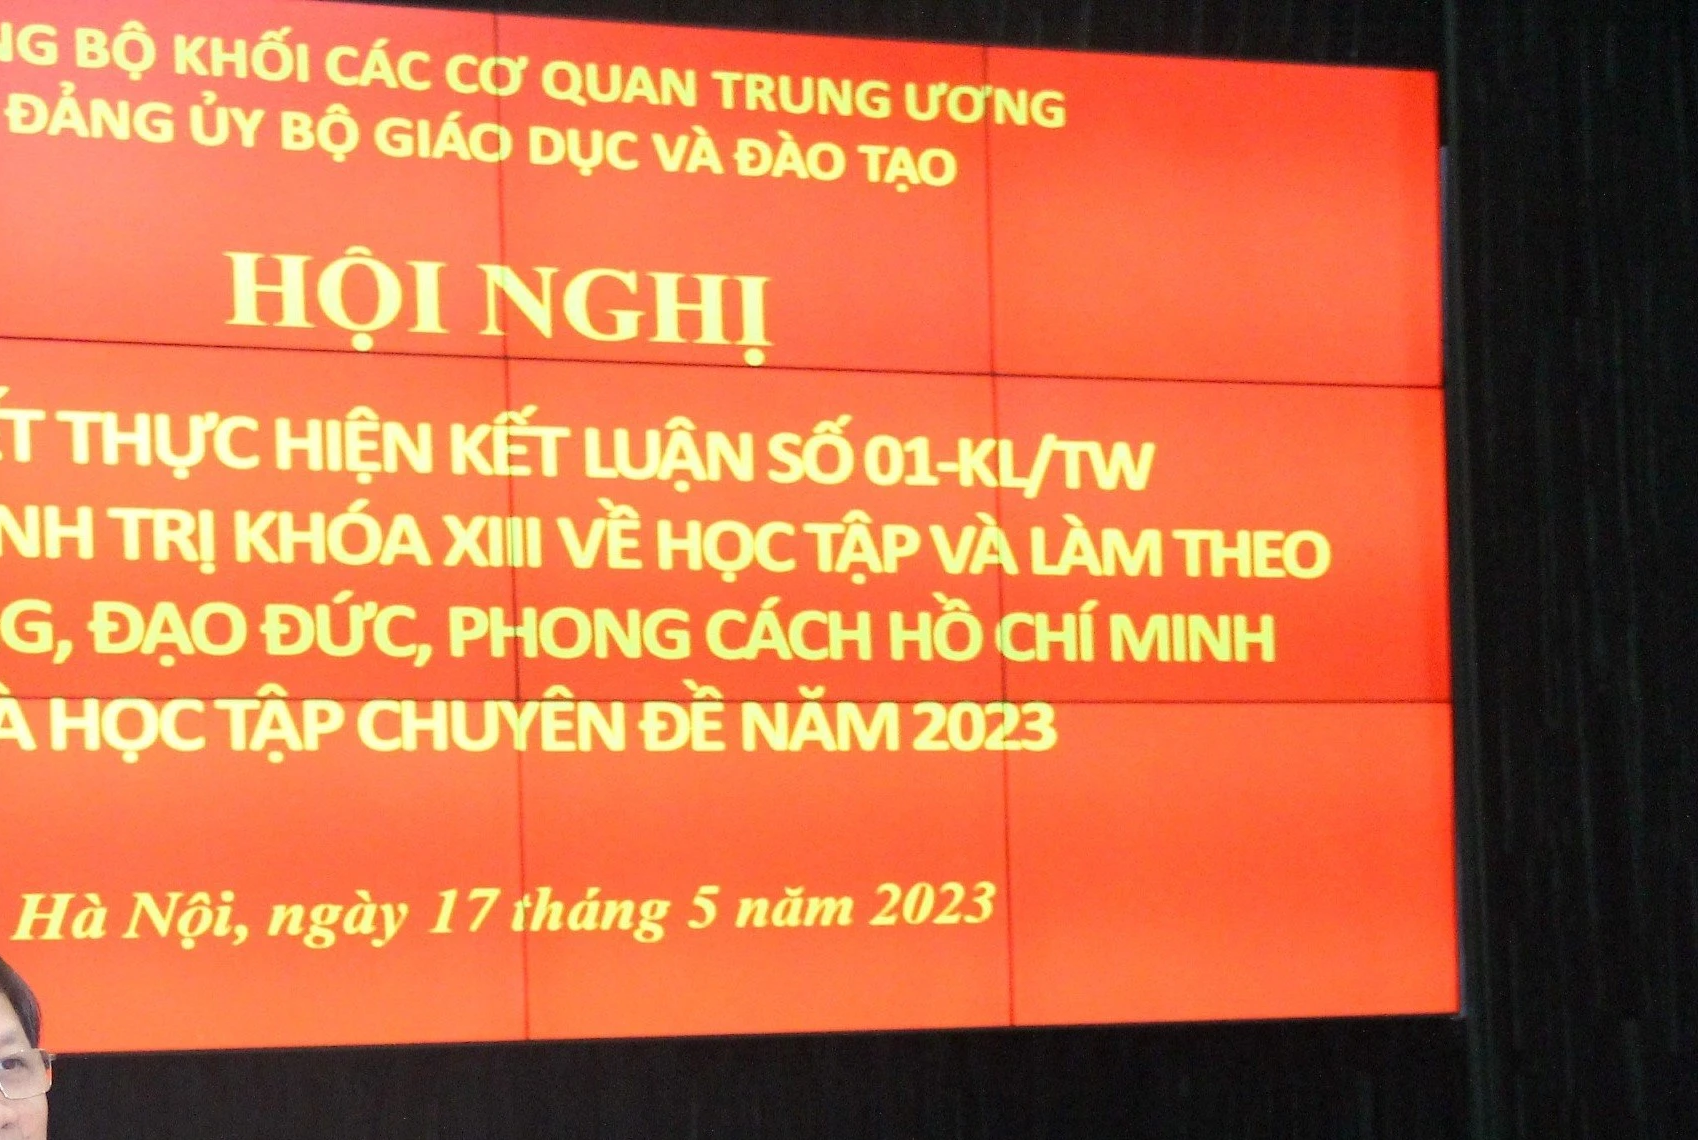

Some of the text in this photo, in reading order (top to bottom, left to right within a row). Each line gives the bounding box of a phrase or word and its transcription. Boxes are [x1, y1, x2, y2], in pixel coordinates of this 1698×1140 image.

[75, 21, 156, 80] BỘ
[174, 27, 309, 82] KHỐI
[326, 38, 431, 91] CÁC
[446, 54, 528, 96] CƠ
[542, 61, 696, 107] QUAN
[712, 71, 891, 118] TRUNG
[905, 82, 1065, 128] ƯƠNG
[4, 81, 956, 192] ĐẢNG ỦY BỘ GIÁO DỤC VÀ ĐÀO TẠO
[225, 246, 770, 365] HỘI NGHỊ
[56, 411, 259, 479] THỰC
[275, 406, 432, 484] HIỆN
[451, 405, 571, 477] KẾT
[585, 416, 754, 492] LUẬN
[768, 415, 854, 484] SỐ
[864, 434, 1155, 498] 01-KL/TW
[107, 507, 215, 574] TRỊ
[234, 498, 432, 566] KHÓA
[443, 515, 542, 567] XIII
[557, 497, 642, 569] VỀ
[657, 519, 795, 582] HỌC
[803, 509, 921, 584] TẬP
[929, 512, 1018, 575] VÀ
[1031, 514, 1162, 576] LÀM
[1172, 529, 1331, 578] THEO
[88, 601, 247, 667] ĐẠO
[260, 590, 432, 667] ĐỨC,
[449, 606, 690, 659] PHONG
[706, 596, 871, 660] CÁCH
[890, 592, 983, 661] HỒ
[995, 600, 1098, 661] CHÍ
[1110, 614, 1275, 662] MINH
[50, 698, 206, 763] HỌC
[214, 683, 345, 763] TẬP
[357, 685, 626, 752] CHUYÊN
[638, 679, 726, 751] ĐỀ
[742, 686, 899, 751] NĂM
[913, 702, 1057, 751] 2023
[12, 881, 996, 949] Hà Nội, ngày 17 tháng 5 năm 2023
